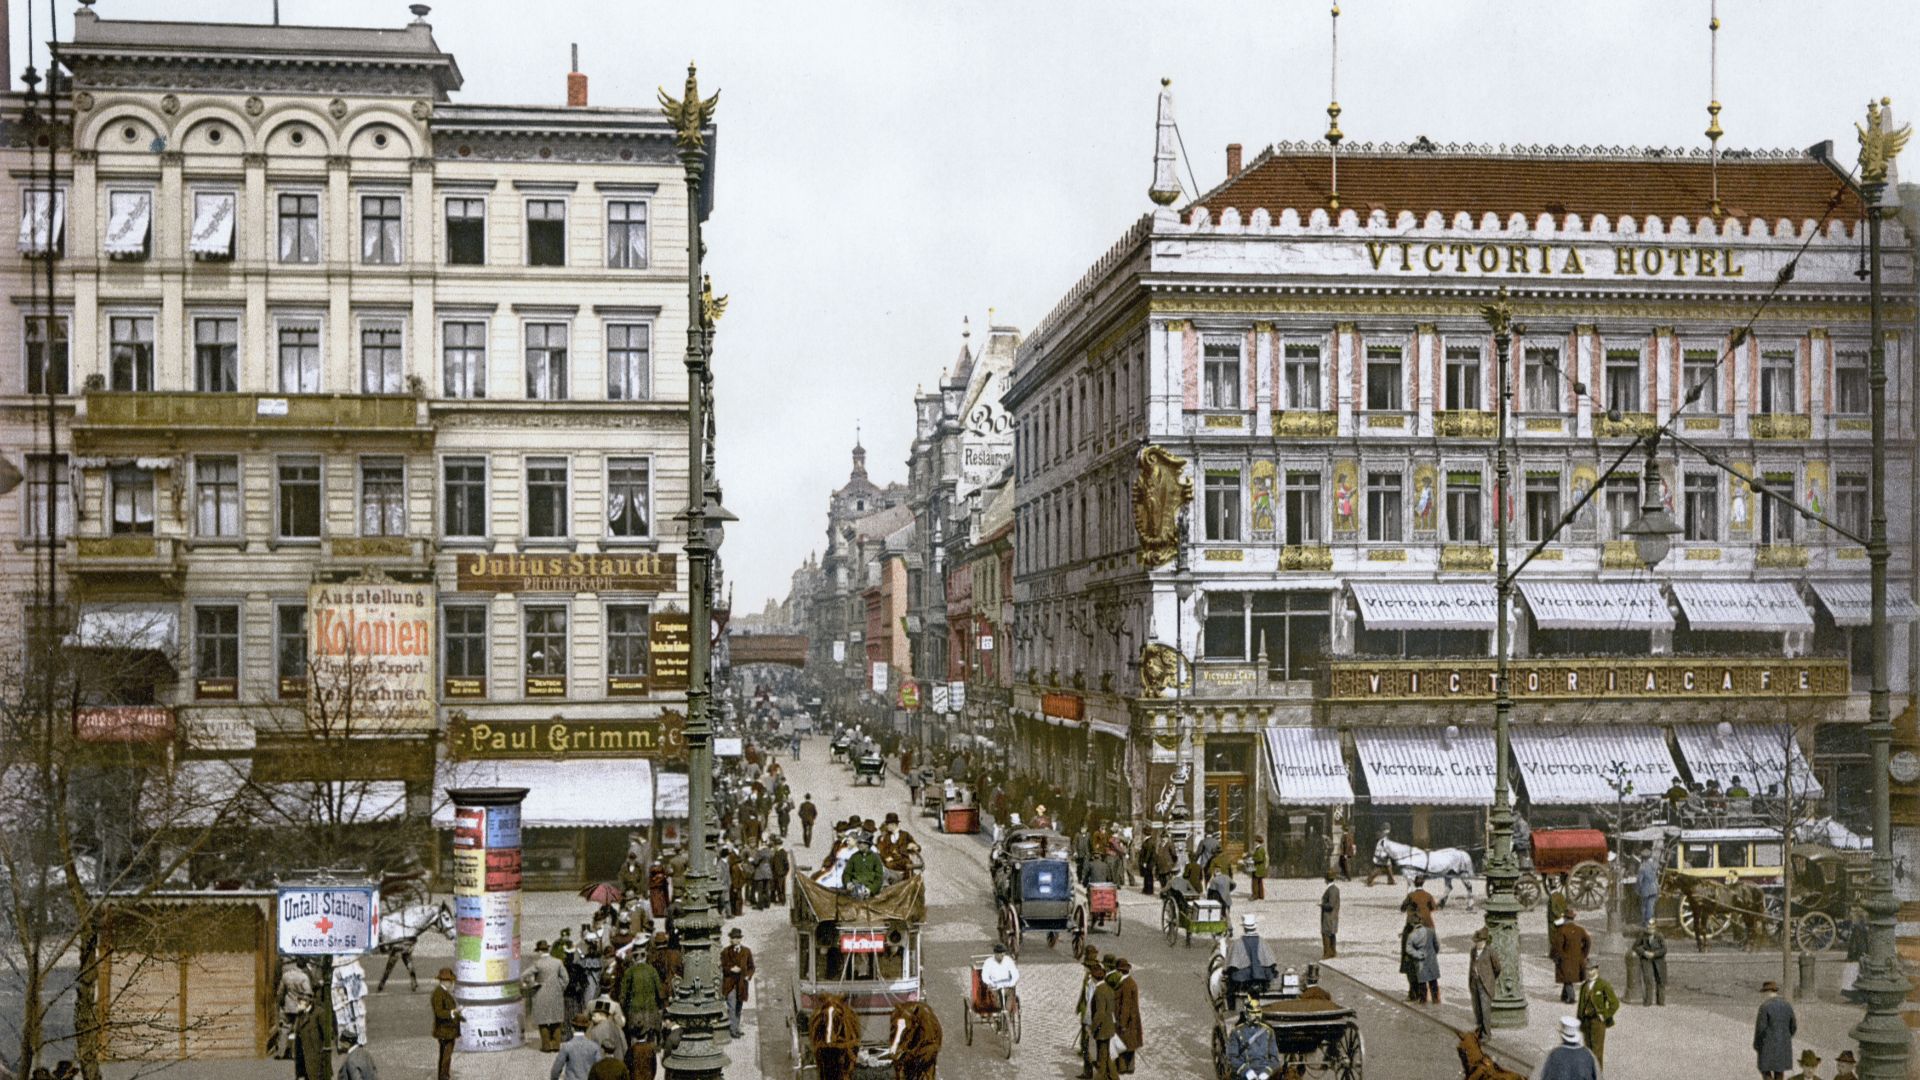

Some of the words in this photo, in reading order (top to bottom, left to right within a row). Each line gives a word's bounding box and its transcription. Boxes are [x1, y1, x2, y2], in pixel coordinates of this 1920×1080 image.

[1365, 241, 1586, 274] VICTORIA
[1614, 246, 1744, 277] HOTEL
[470, 554, 562, 577] Julius
[569, 554, 662, 577] Staudt
[317, 589, 425, 608] Ausstellung
[1364, 598, 1450, 608] VICTORIA
[1534, 597, 1614, 608] VICTORIA
[314, 608, 430, 656] Kolonien
[1683, 671, 1809, 691] CAFE
[470, 723, 537, 751] Paul
[1276, 763, 1322, 780] VICTORIA
[1369, 762, 1443, 776] VICTORIA
[1450, 762, 1497, 776] CAFE
[1523, 762, 1615, 775] VICTORIA
[284, 894, 320, 922] Unfall
[322, 893, 365, 922] Station
[291, 936, 325, 948] Kronen
